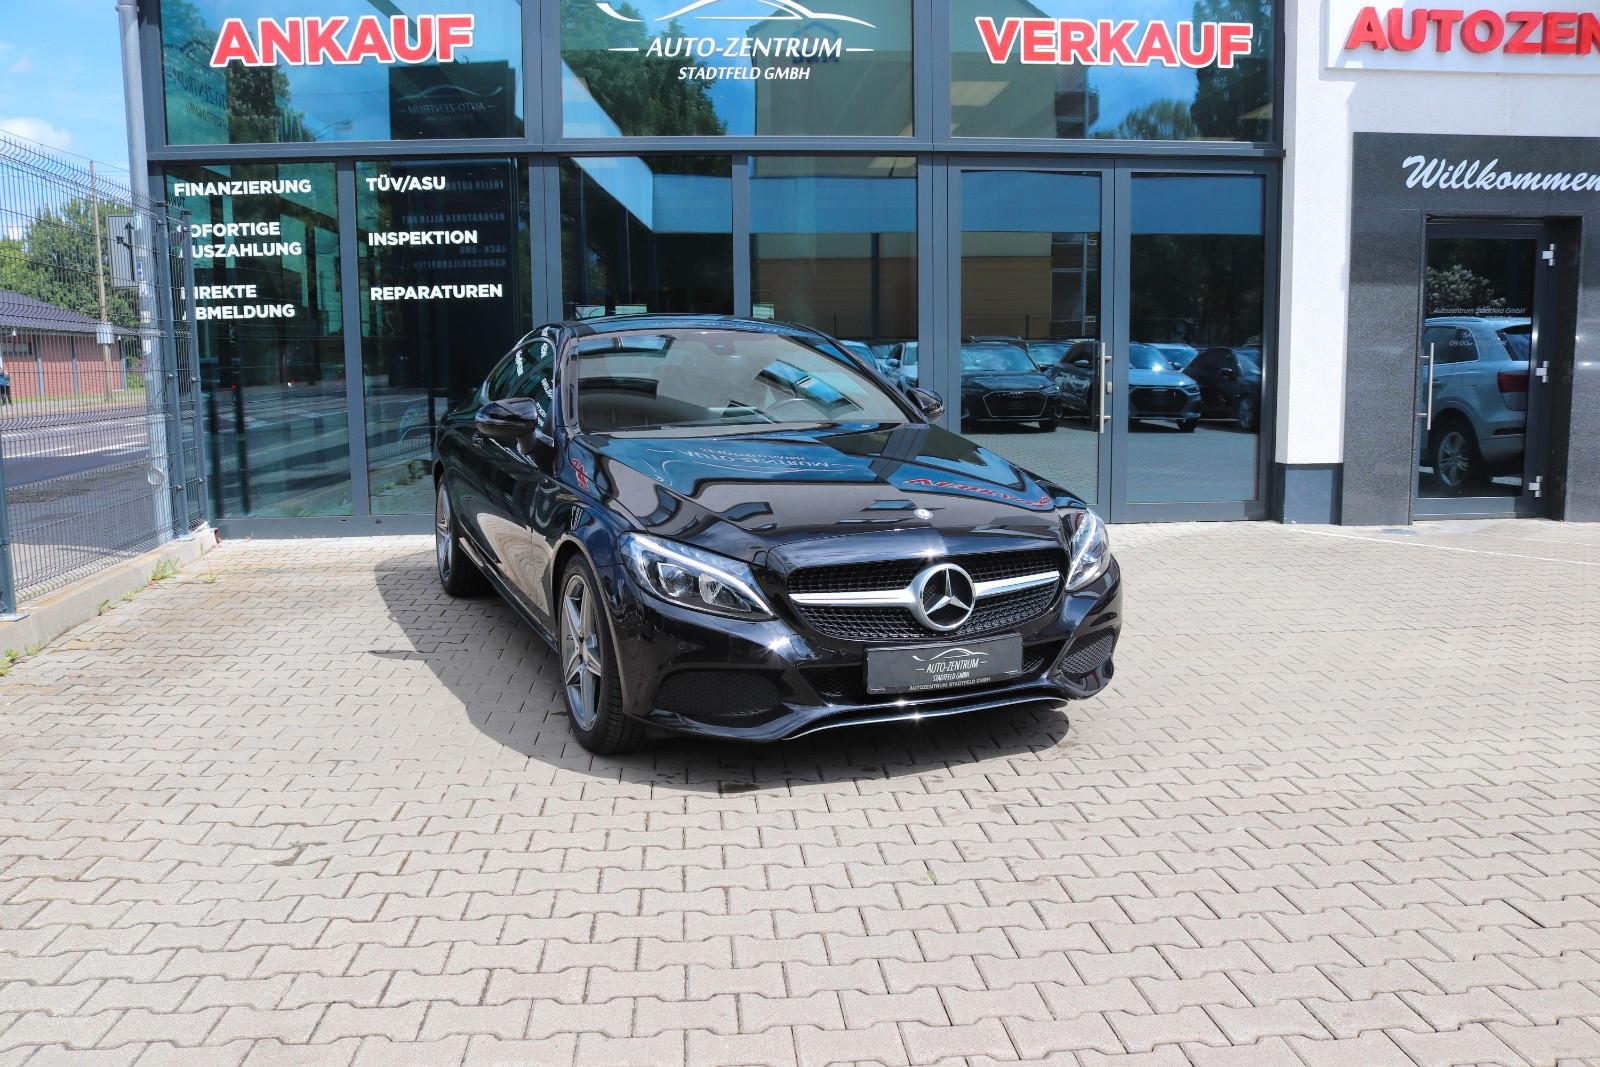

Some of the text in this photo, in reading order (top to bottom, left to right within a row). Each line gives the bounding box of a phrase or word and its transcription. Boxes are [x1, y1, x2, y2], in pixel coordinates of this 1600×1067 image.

[209, 14, 475, 68] ANKAUF
[645, 37, 843, 58] AUTO-ZENTRUM
[974, 16, 1254, 69] VERKAUF
[678, 66, 811, 80] STADTFELD GMBH
[1402, 155, 1600, 192] Willkommen
[174, 180, 312, 197] FINANZIERUNG
[366, 174, 446, 192] TÜV/ASU
[368, 230, 478, 246] INSPEKTION
[179, 242, 302, 259] USZAHLUNG
[181, 285, 257, 300] IREKTE
[370, 284, 503, 301] REPARATUREN
[182, 304, 295, 321] BMELDUNG
[926, 658, 979, 674] AUTO-ZENTRUM
